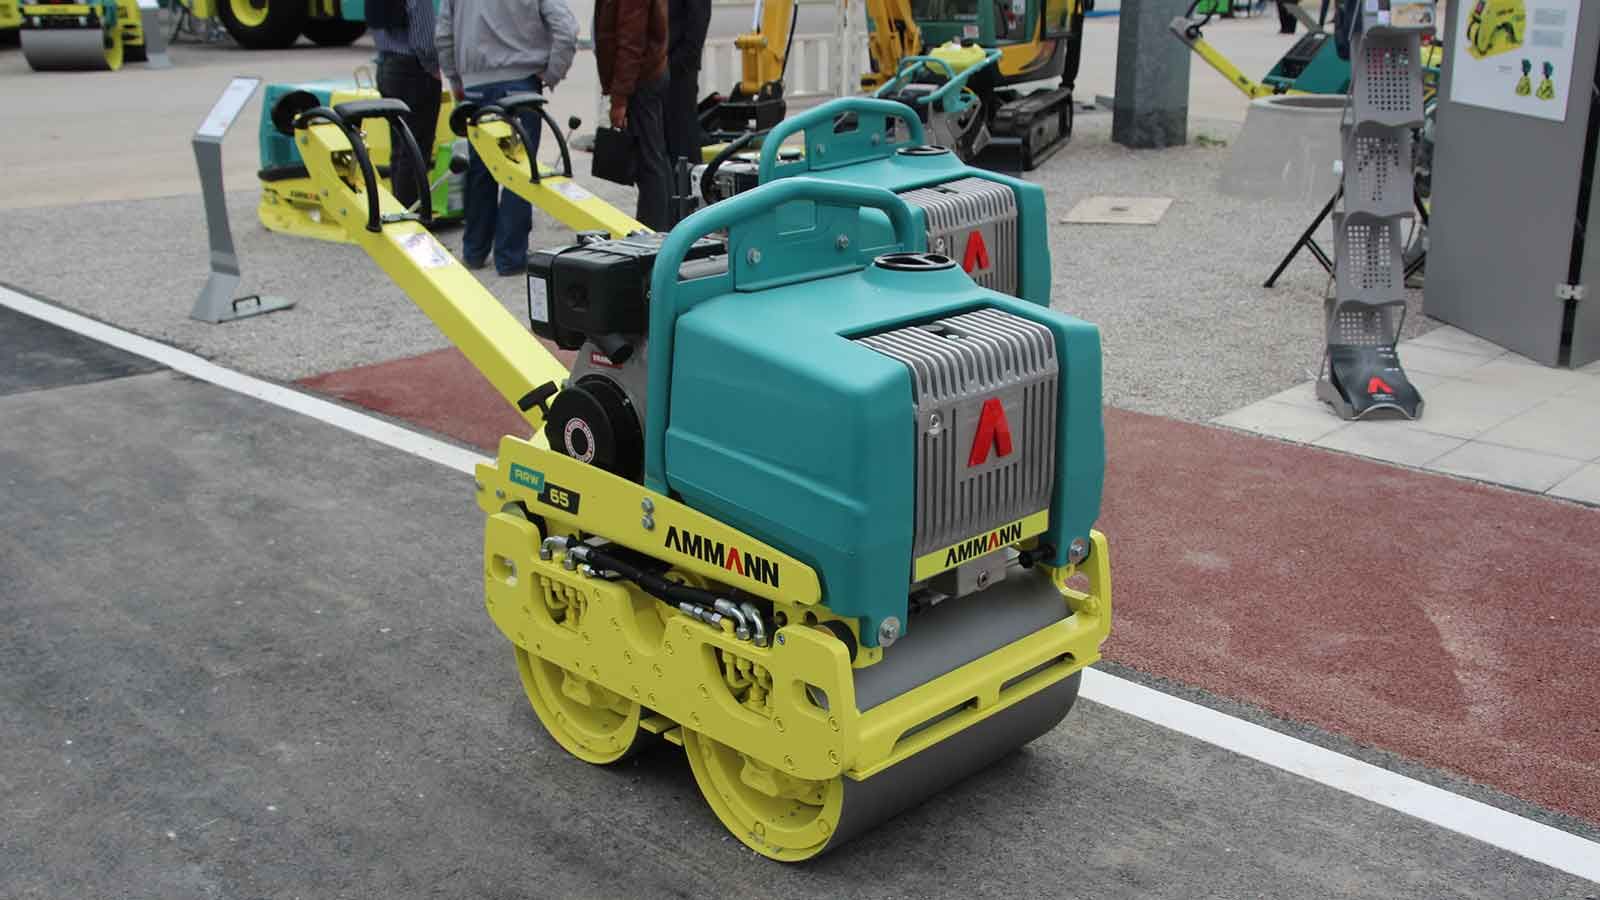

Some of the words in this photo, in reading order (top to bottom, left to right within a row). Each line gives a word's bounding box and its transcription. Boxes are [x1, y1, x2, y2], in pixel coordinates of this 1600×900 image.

[550, 488, 569, 507] 65
[664, 525, 780, 588] AMMANN
[945, 521, 1022, 568] AMMANN
